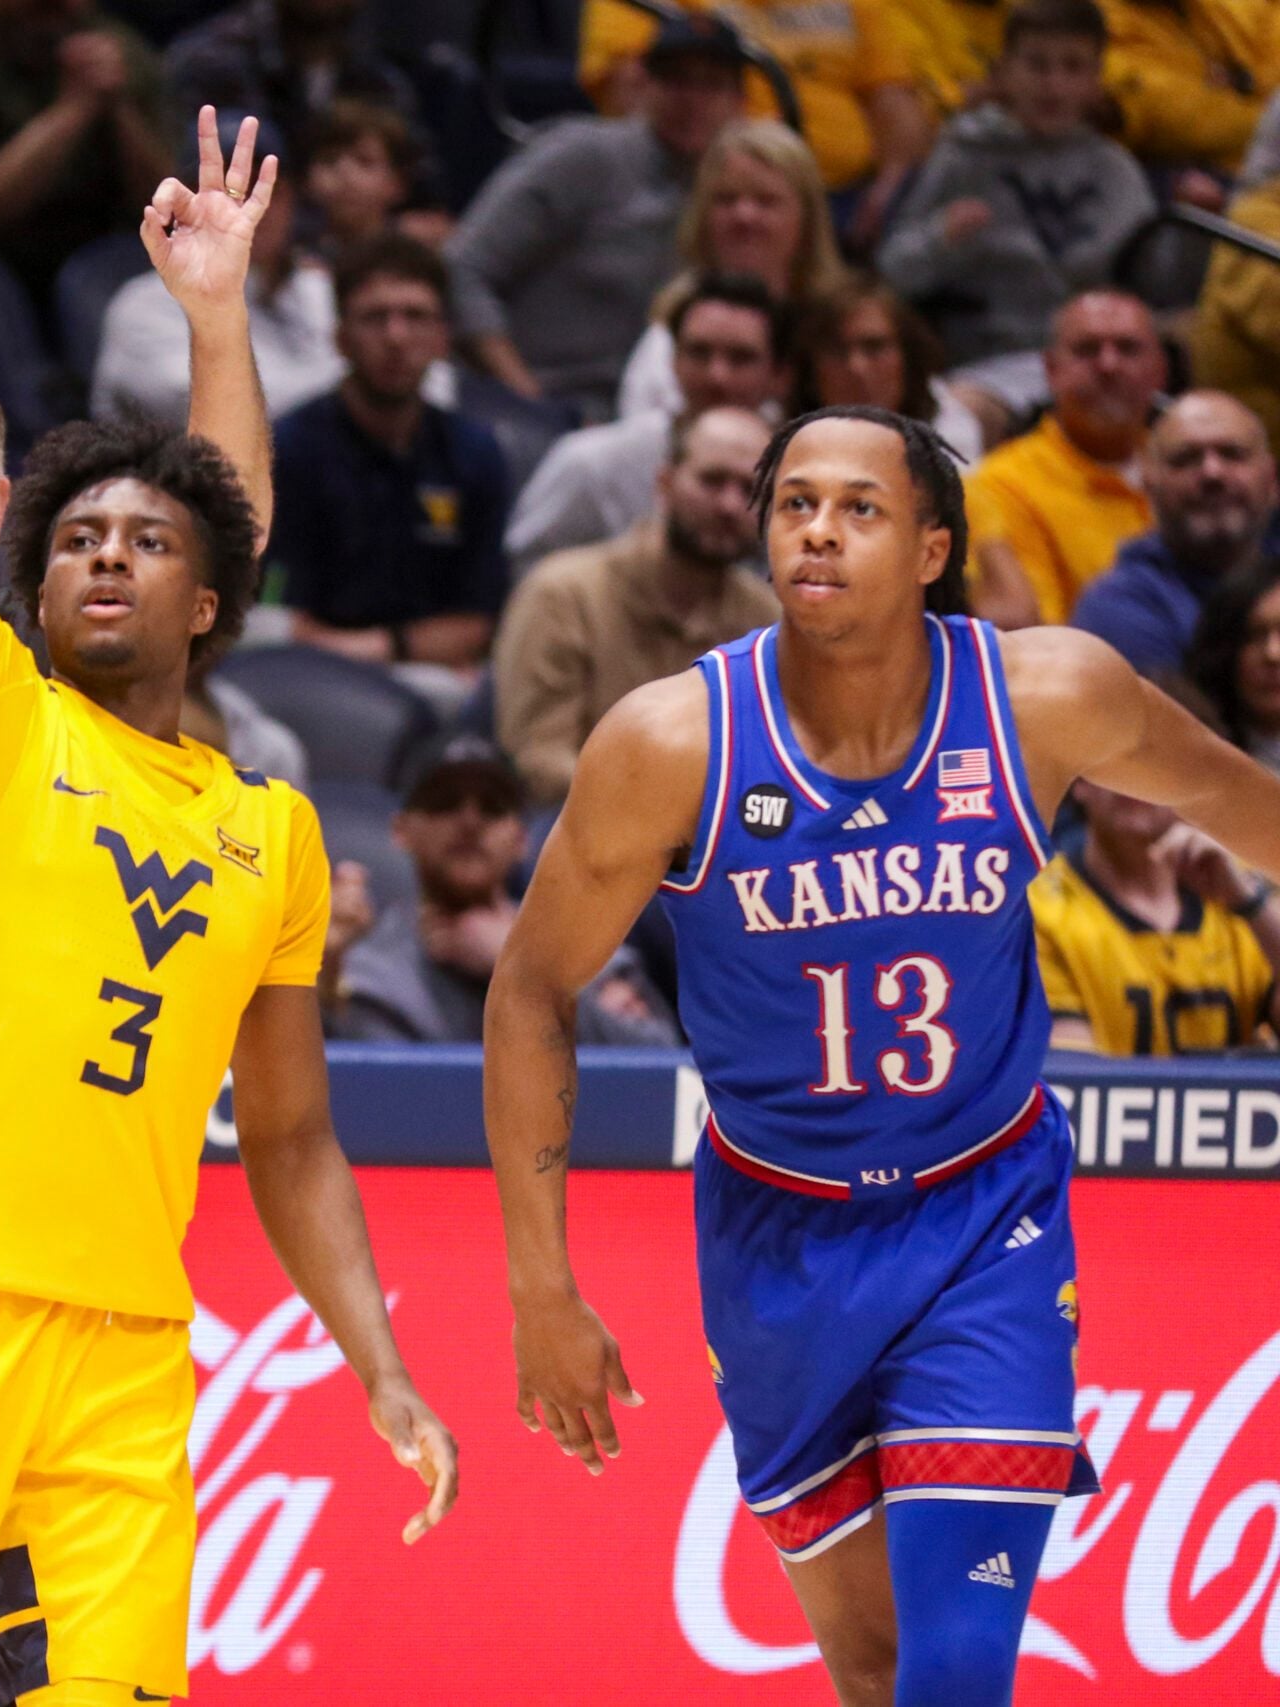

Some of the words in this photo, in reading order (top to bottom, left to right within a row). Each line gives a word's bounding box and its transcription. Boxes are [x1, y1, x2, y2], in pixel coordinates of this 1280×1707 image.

[744, 794, 787, 827] SW
[938, 785, 995, 822] XII
[726, 842, 1010, 932] KANSAS
[80, 977, 163, 1096] 3
[802, 952, 960, 1098] 13
[860, 1168, 900, 1185] KU
[968, 1570, 1015, 1589] adidas
